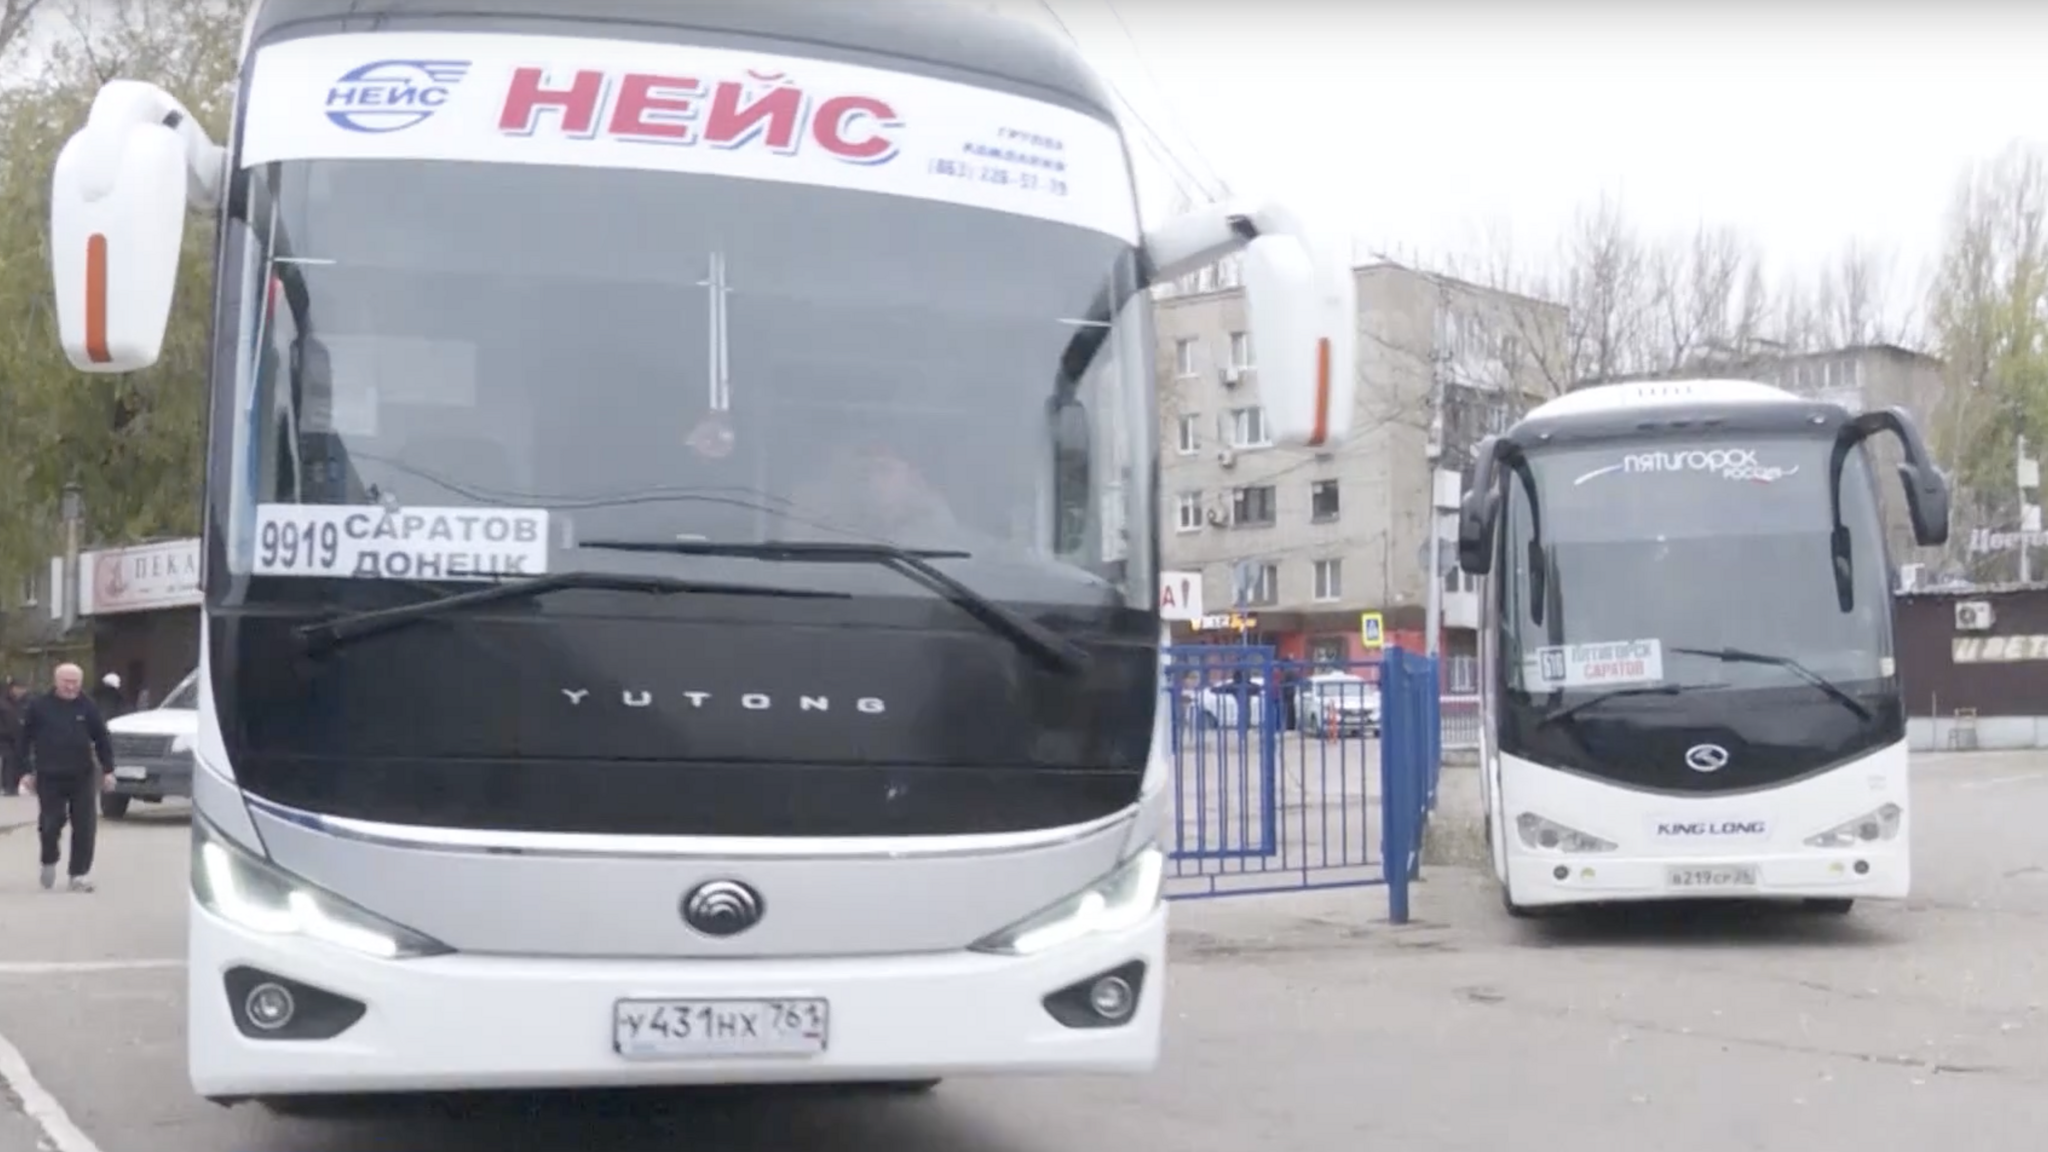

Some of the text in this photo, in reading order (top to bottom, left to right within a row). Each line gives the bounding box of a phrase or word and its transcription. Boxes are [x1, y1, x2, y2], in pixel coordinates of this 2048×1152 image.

[325, 80, 449, 106] НЕЙС
[498, 67, 905, 165] НЕЙС
[345, 513, 538, 542] САРАТОВ
[261, 521, 338, 568] 9919
[352, 551, 528, 577] ДОНЕЦК
[561, 688, 886, 714] YUTONG
[1657, 821, 1765, 835] KING LONG
[627, 1007, 757, 1038] У431НХ
